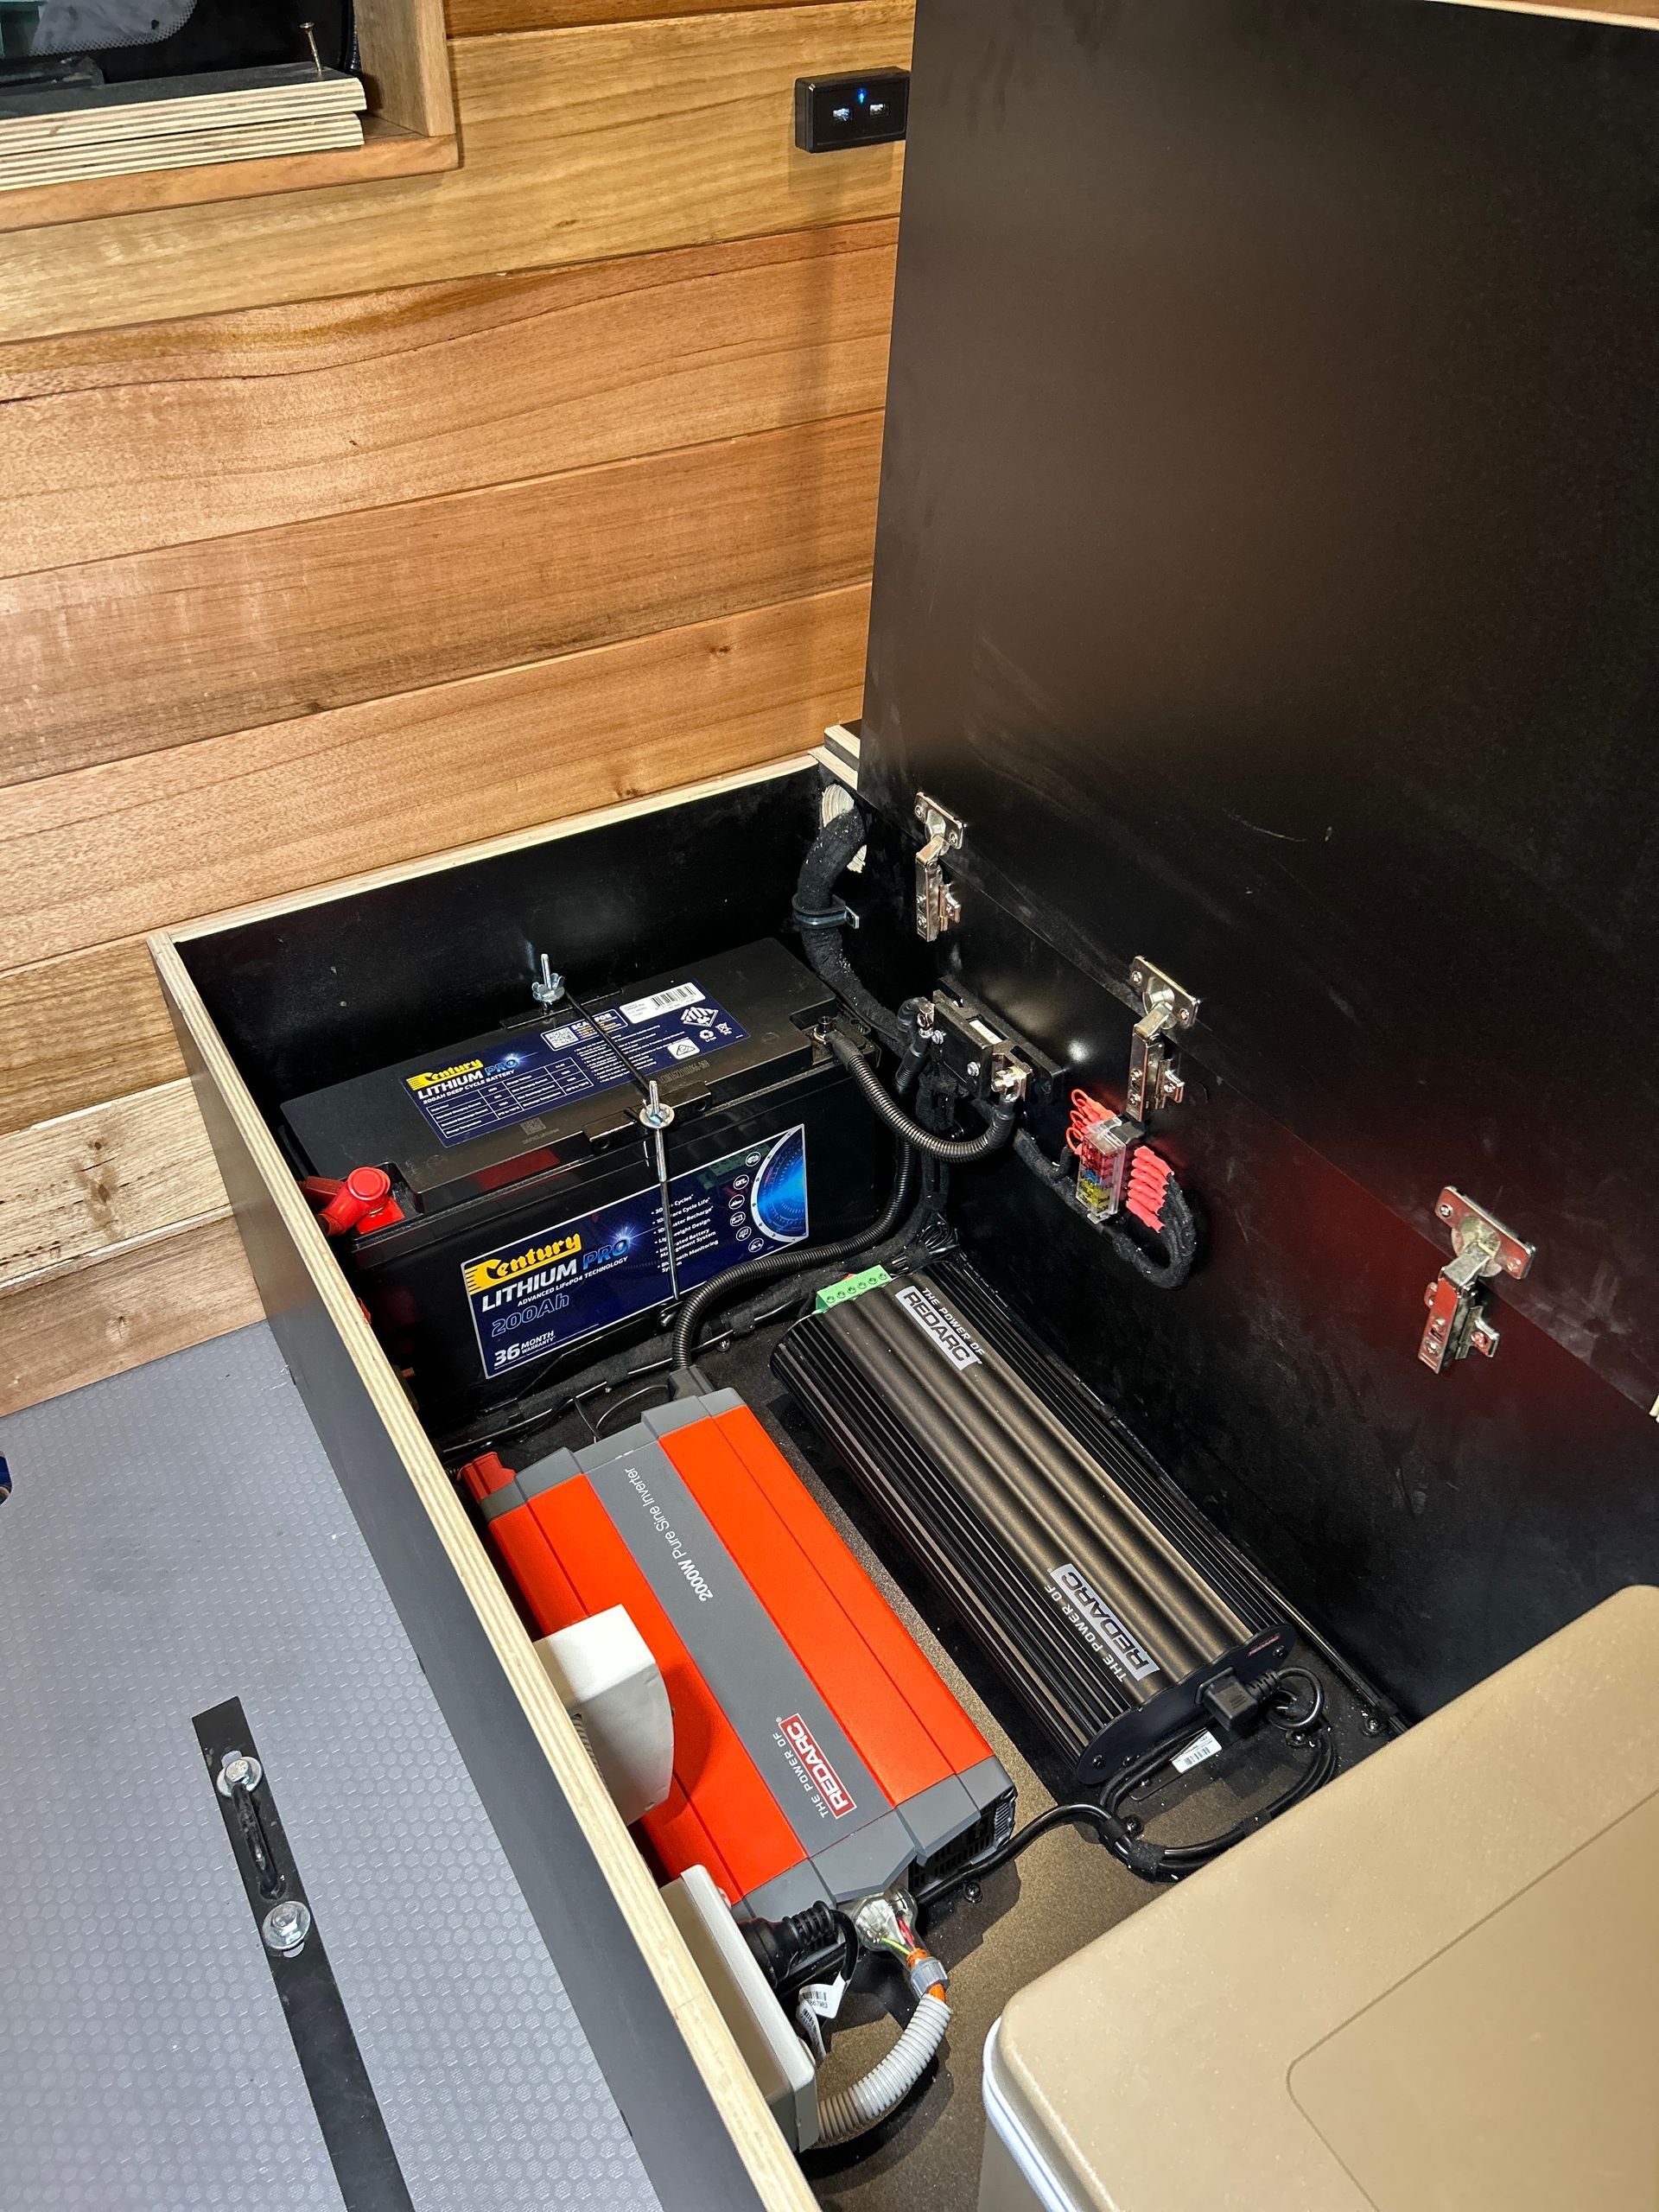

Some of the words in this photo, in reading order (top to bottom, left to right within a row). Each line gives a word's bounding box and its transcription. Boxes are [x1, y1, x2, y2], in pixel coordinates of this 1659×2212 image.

[571, 1020, 589, 1031] SCA
[406, 1059, 483, 1090] Century
[417, 1071, 483, 1099] LITHIUM
[485, 1059, 518, 1077] PRO
[423, 1093, 446, 1105] 200AH
[447, 1087, 463, 1096] DEEP
[465, 1080, 486, 1090] CYCLE
[486, 1070, 515, 1083] BATTERY
[683, 1204, 697, 1212] Cycle
[658, 1226, 691, 1243] Ligweight
[692, 1218, 710, 1229] Design
[659, 1237, 689, 1252] Intated
[689, 1229, 709, 1240] Battery
[660, 1240, 696, 1258] Mgement
[696, 1231, 716, 1243] System
[689, 1240, 719, 1255] Monitoring
[464, 1232, 582, 1295] Century
[482, 1259, 576, 1313] LITHIUM
[582, 1238, 629, 1269] PRO
[518, 1287, 555, 1306] ADVANCED
[556, 1275, 583, 1291] LiFePO4
[585, 1255, 628, 1279] TECHNOLOGY
[492, 1294, 569, 1338] 200Ah
[903, 1291, 970, 1362] REDARC
[922, 1287, 940, 1306] THE
[938, 1306, 971, 1340] POWER
[970, 1342, 986, 1356] OF
[493, 1343, 520, 1366] 36
[521, 1330, 554, 1350] MONTH
[625, 1467, 655, 1507] Inverter
[650, 1505, 670, 1532] Sine
[665, 1530, 687, 1560] Pure
[677, 1559, 714, 1602] 2000W
[1044, 1585, 1063, 1601] OF
[1061, 1572, 1149, 1670] REDARC
[1062, 1604, 1103, 1652] POWER
[1103, 1654, 1127, 1682] THE
[772, 1732, 786, 1747] OF
[784, 1750, 813, 1792] POWER
[786, 1721, 849, 1811] REDARC
[811, 1794, 829, 1819] THE
